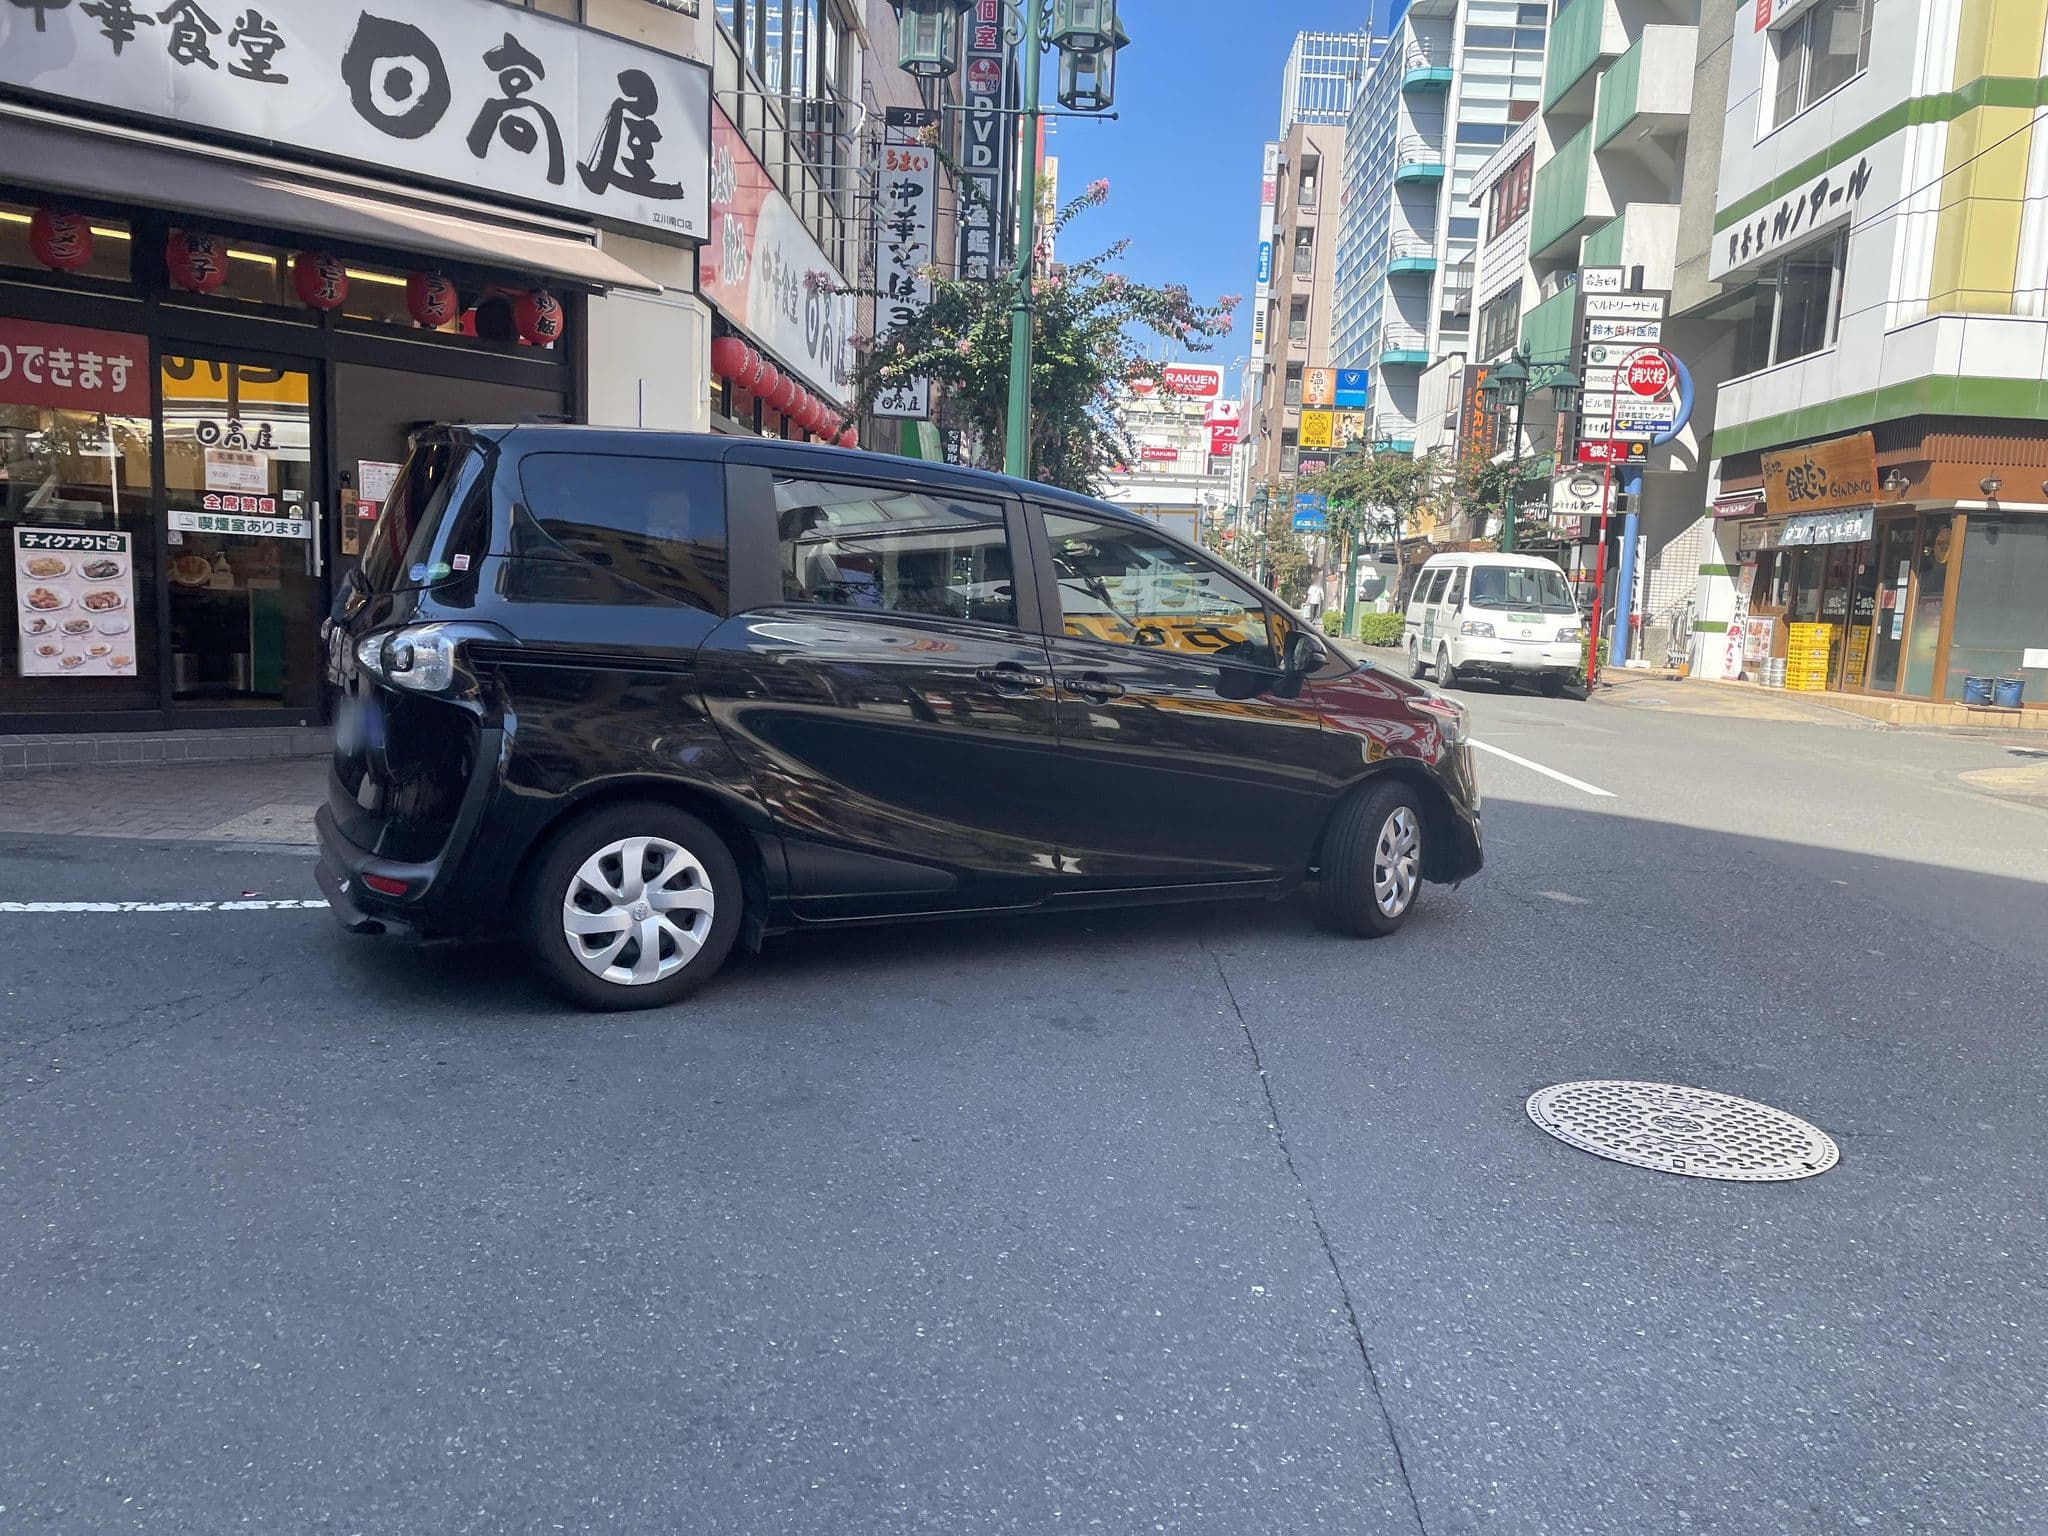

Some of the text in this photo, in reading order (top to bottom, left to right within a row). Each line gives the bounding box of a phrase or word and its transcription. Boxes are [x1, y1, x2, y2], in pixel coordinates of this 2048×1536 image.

[341, 10, 685, 200] 日高屋
[903, 112, 925, 125] 2F
[972, 96, 994, 166] DVD
[886, 149, 928, 172] うまい
[652, 212, 694, 231] 立川南口店
[1259, 244, 1270, 279] Berlitz
[1592, 324, 1659, 338] 鈴木歯科医院
[1165, 373, 1218, 386] RAKUEN
[1630, 367, 1666, 385] 消火栓
[196, 418, 279, 450] 日高屋
[1785, 455, 1828, 502] 銀だこ
[203, 494, 276, 513] 全席禁煙
[198, 515, 303, 536] 喫煙室あります
[24, 534, 106, 550] テイクアウト
